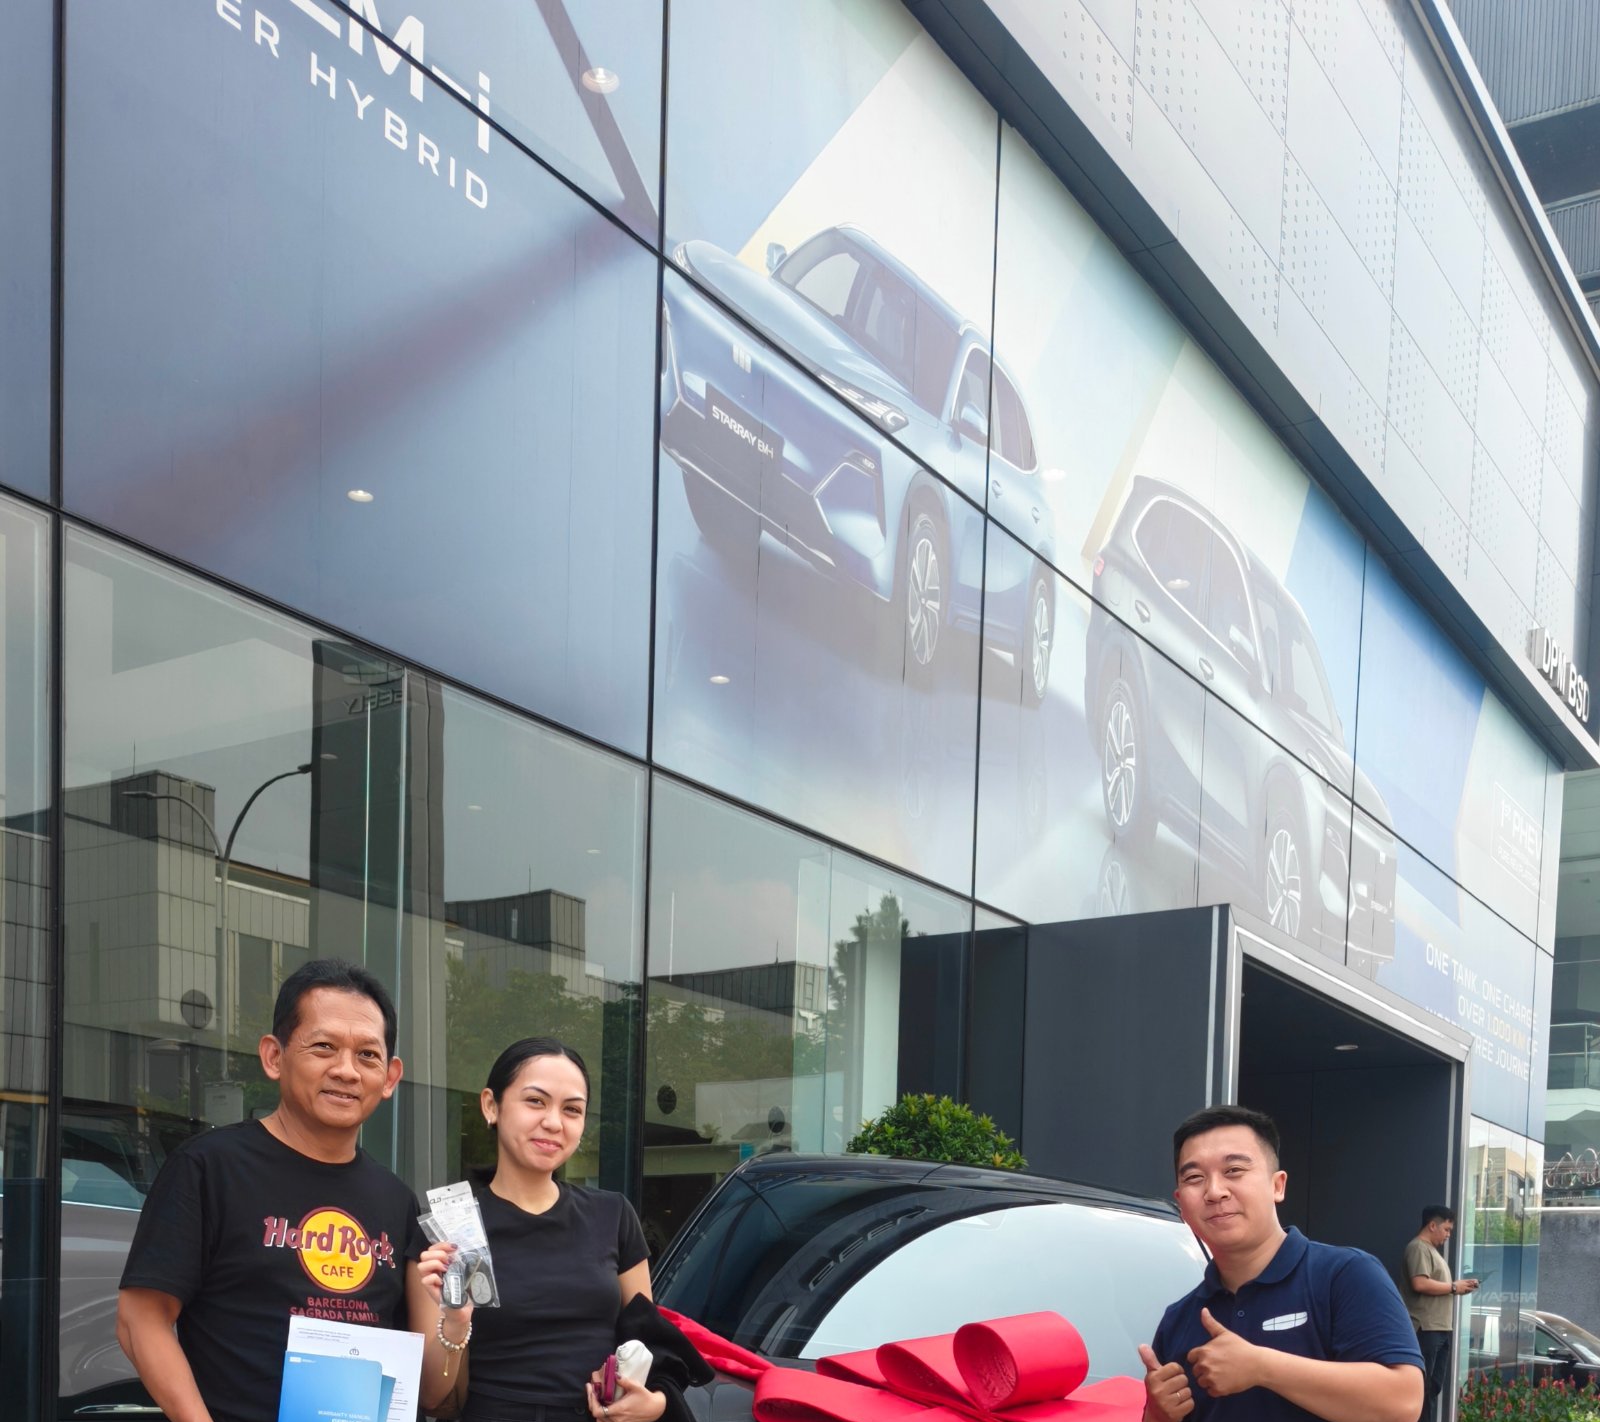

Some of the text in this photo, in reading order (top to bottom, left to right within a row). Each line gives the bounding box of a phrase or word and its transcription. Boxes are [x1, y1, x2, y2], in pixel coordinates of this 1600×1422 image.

[310, 51, 488, 209] HYBRID
[712, 404, 757, 447] STARRAY
[1542, 628, 1590, 724] DPM BSD
[1425, 942, 1449, 976] ONE
[1482, 979, 1503, 1009] ONE
[1457, 995, 1485, 1028] OVER
[263, 1216, 335, 1253] Hard
[338, 1225, 396, 1269] Rock
[321, 1264, 354, 1279] CAFE
[290, 1306, 345, 1321] SAGRADA
[307, 1296, 370, 1311] BARCELONA
